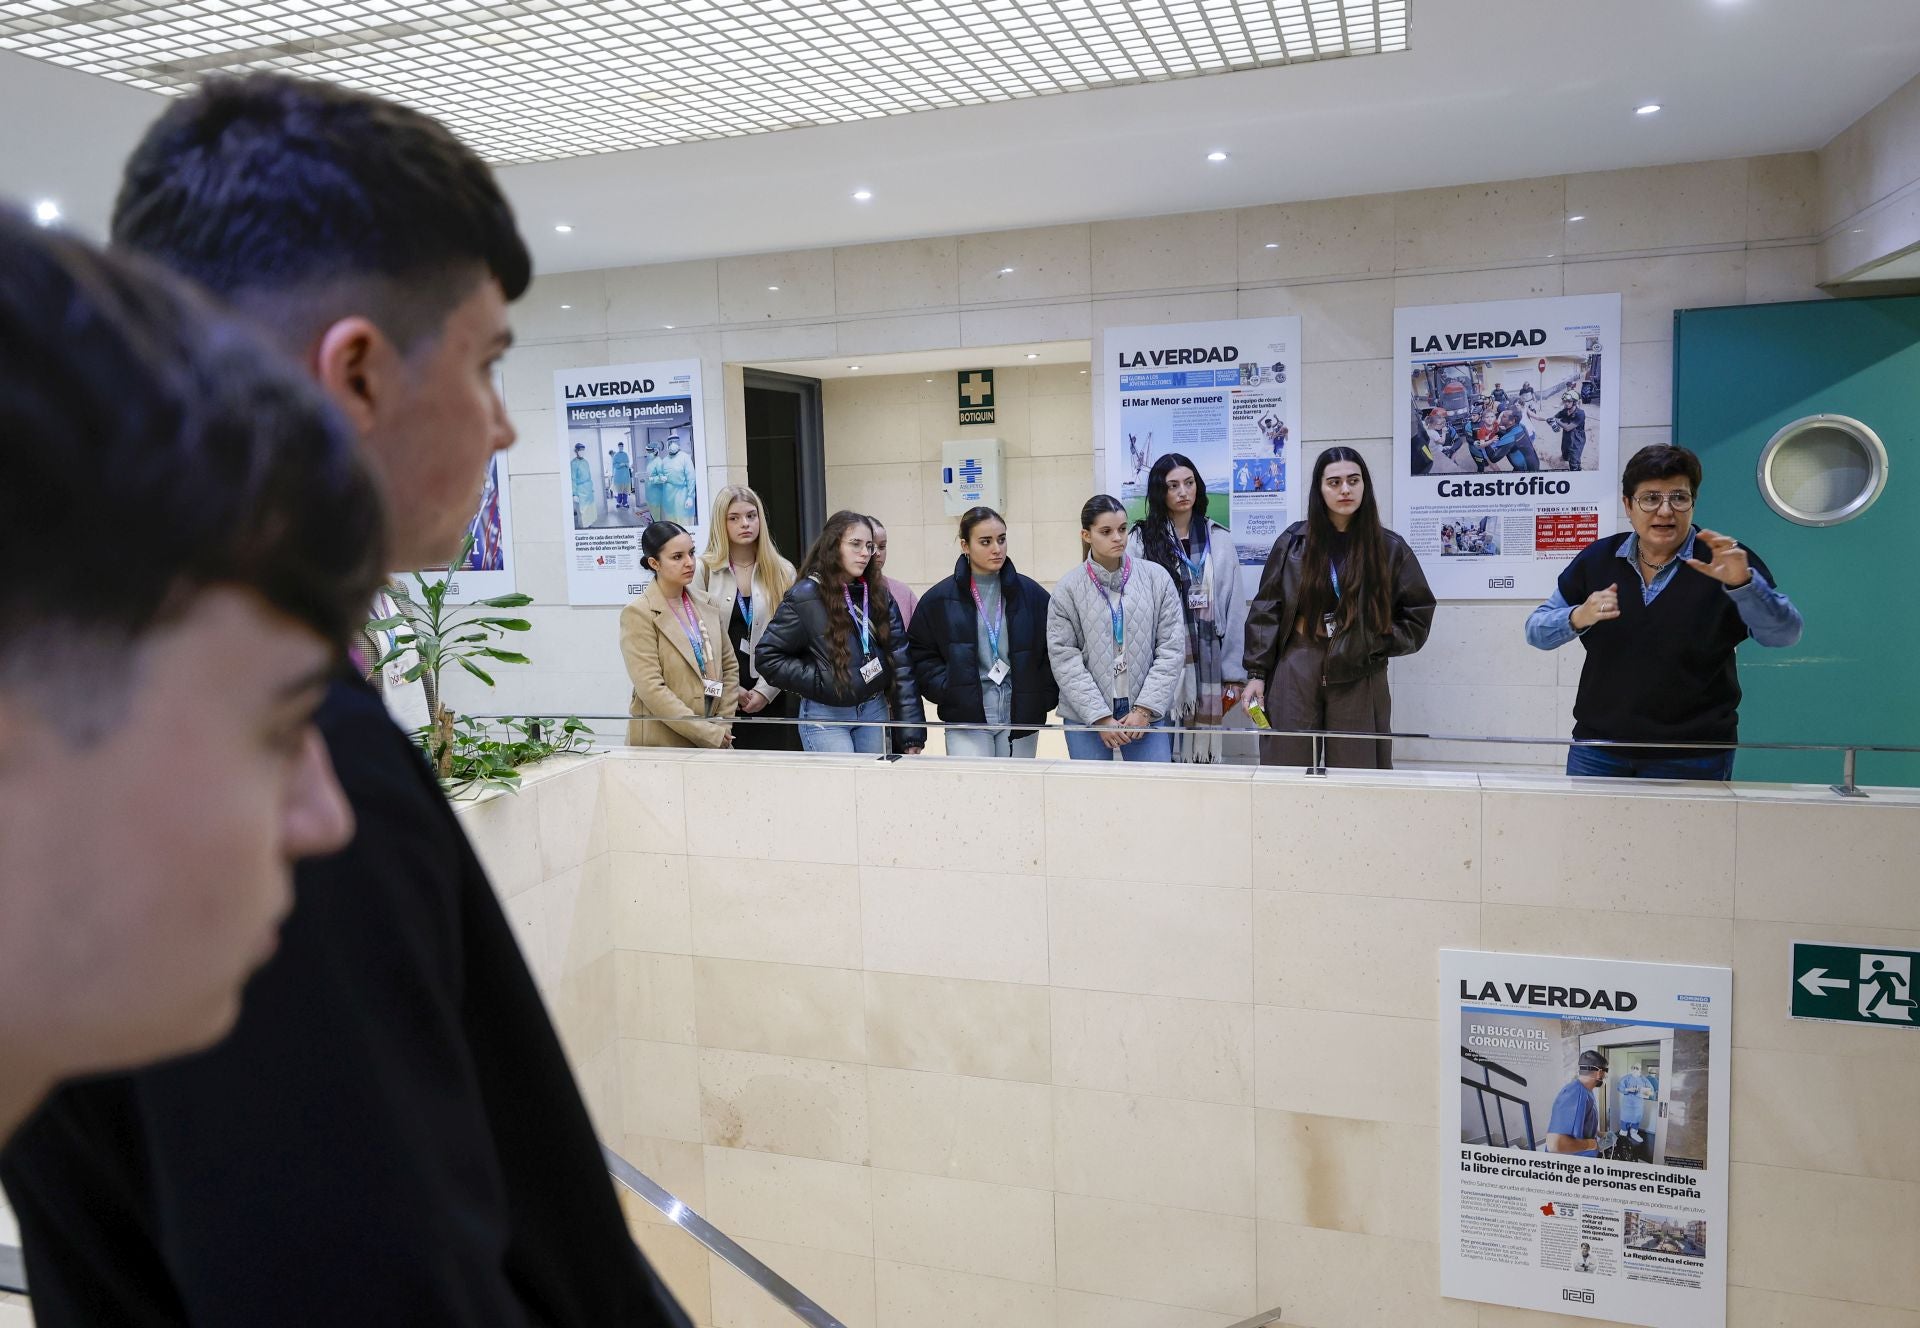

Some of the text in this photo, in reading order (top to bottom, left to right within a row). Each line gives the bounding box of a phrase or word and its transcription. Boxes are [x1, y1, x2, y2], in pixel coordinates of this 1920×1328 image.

[1411, 329, 1547, 353] LA VERDAD
[1119, 346, 1238, 368] LA VERDAD
[565, 379, 654, 398] LA VERDAD
[1123, 399, 1130, 407] El
[1132, 398, 1149, 406] Mar
[1151, 397, 1180, 406] Menor
[1193, 395, 1223, 404] muere
[572, 402, 684, 420] Héroes de la pandemia
[960, 411, 994, 422] BOTIQUIN
[1437, 476, 1570, 498] Catastrófico
[1460, 979, 1638, 1012] LA VERDAD
[1470, 1024, 1549, 1040] EN BUSCA DEL
[1468, 1036, 1550, 1052] CORONAVIRUS
[1461, 1150, 1696, 1186] El Gobierno restringe a lo imprescindible
[1461, 1162, 1701, 1199] la libre circulación de personas en España
[1476, 1181, 1498, 1189] Sánchez
[1651, 1201, 1673, 1210] poderes
[1560, 1208, 1574, 1217] 53
[1633, 1252, 1657, 1261] Región
[1658, 1256, 1675, 1264] echa
